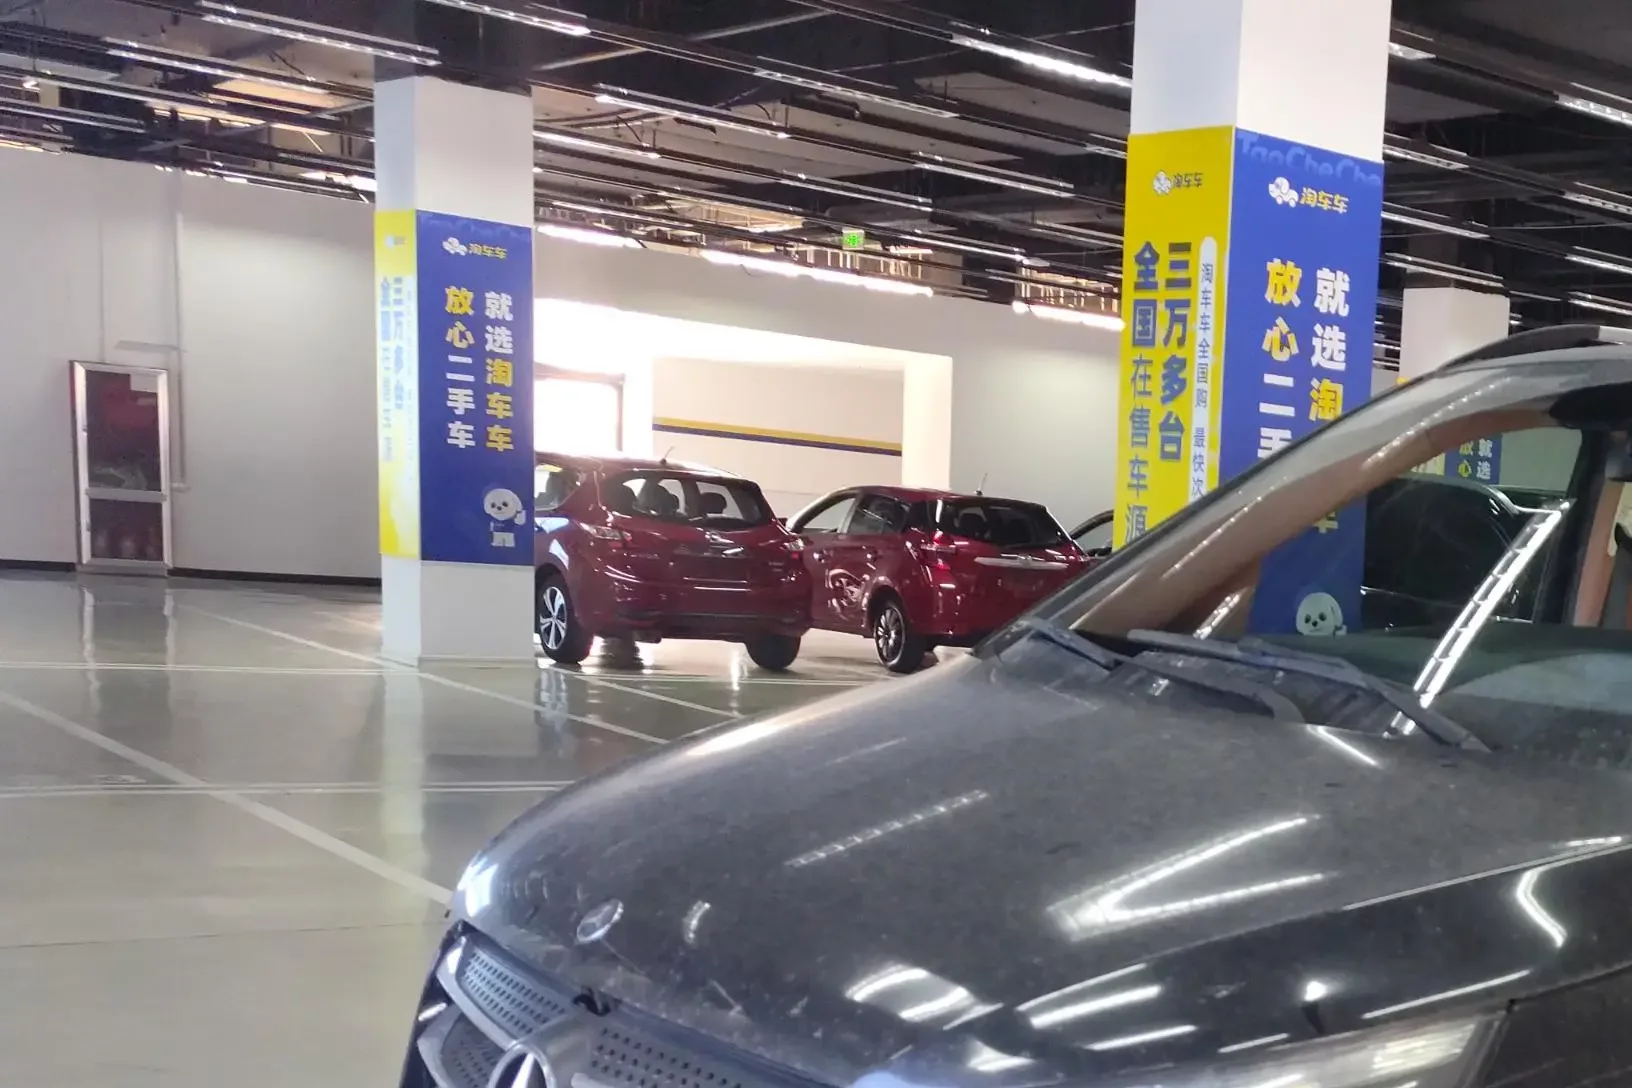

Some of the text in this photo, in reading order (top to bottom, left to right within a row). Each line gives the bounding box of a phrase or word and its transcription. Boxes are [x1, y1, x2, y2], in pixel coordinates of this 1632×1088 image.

[468, 242, 508, 260] 淘车车
[1172, 172, 1203, 188] 淘车车
[1300, 187, 1349, 214] 淘车车
[444, 286, 476, 449] 放心二手车
[484, 291, 514, 452] 就选淘车车
[1125, 241, 1160, 544] 全国在售车源
[1158, 241, 1193, 461] 三万多台
